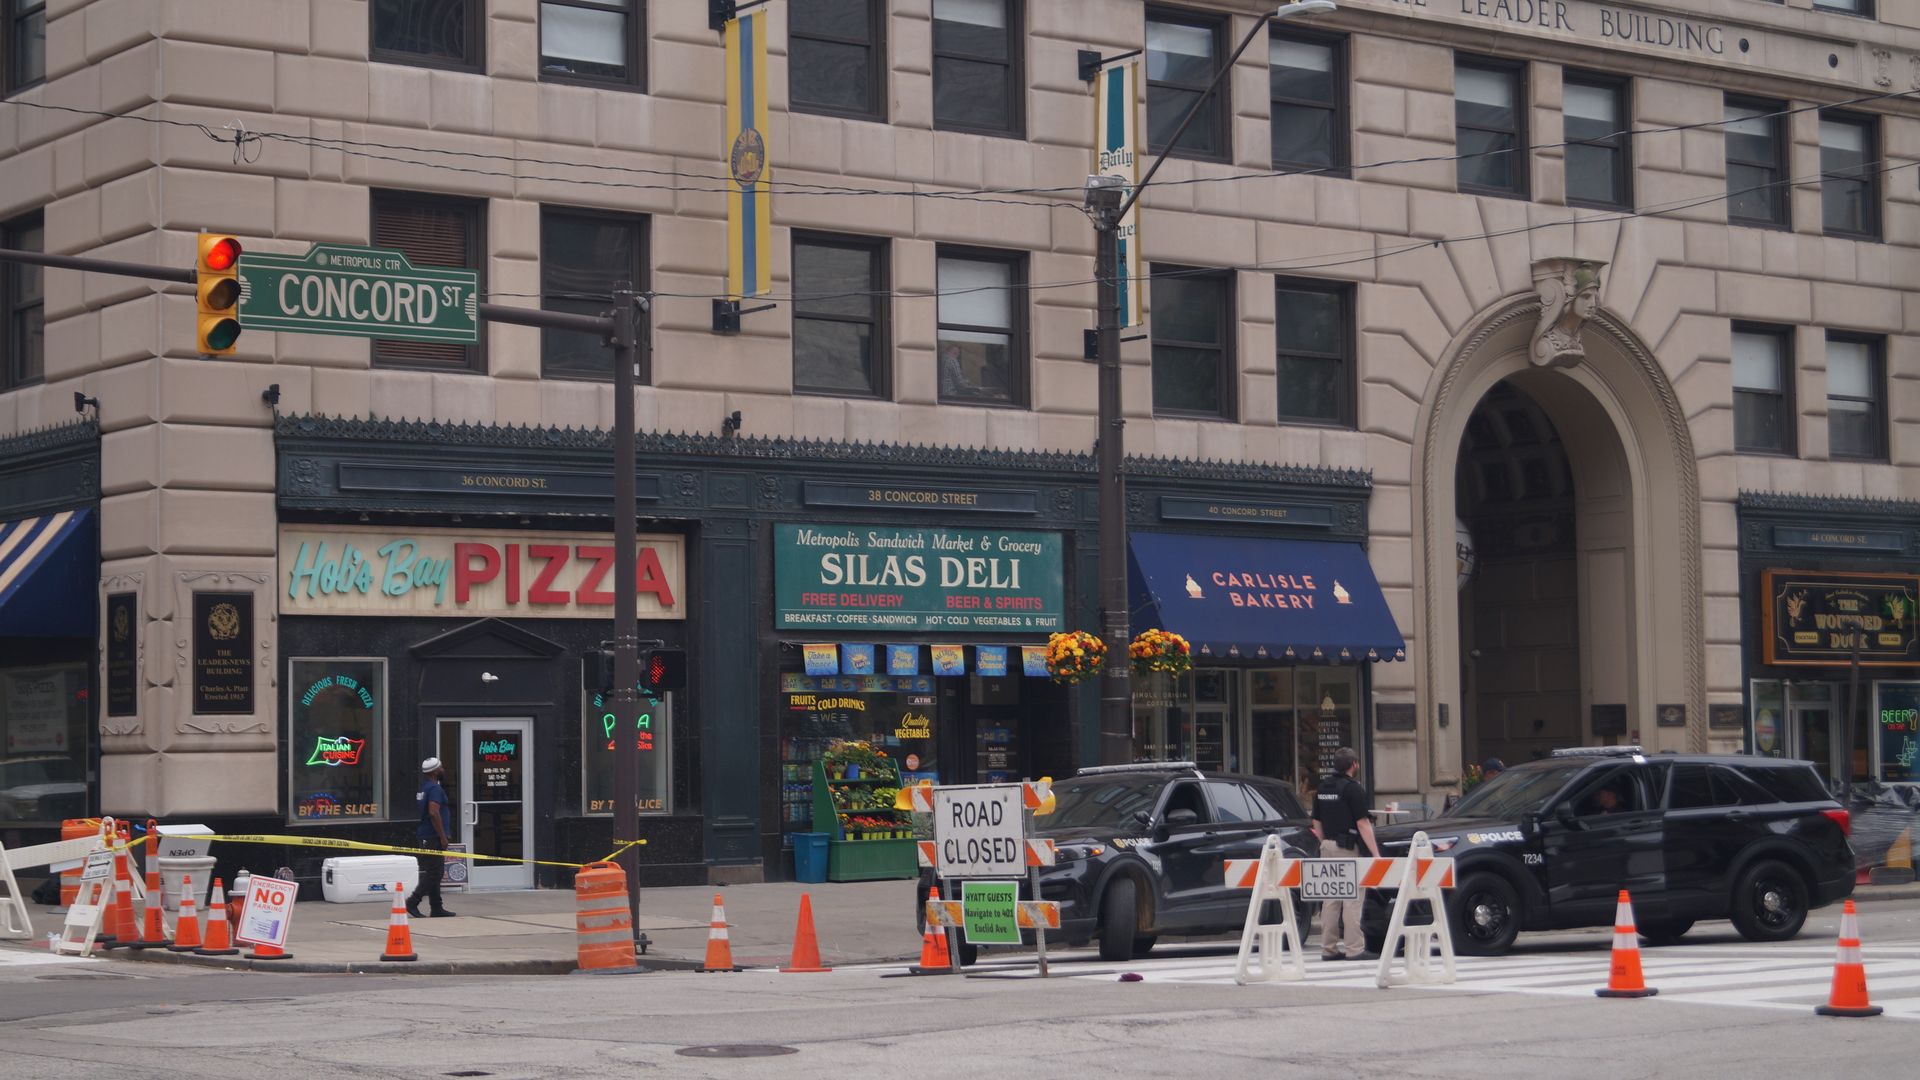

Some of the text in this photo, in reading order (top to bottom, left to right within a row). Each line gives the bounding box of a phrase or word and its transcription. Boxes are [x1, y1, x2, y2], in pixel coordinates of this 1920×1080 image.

[1599, 8, 1723, 54] BUILDING
[1099, 149, 1133, 170] Daily
[330, 254, 400, 270] METROPOLIS CTR
[278, 273, 461, 324] CONCORD ST
[462, 475, 547, 488] 36 CONCORD ST.
[869, 491, 978, 505] 38 CONCORD STREET
[1208, 506, 1287, 518] 40 CONCORD STREET
[797, 528, 1042, 555] Metropolis Sandwich Market & Grocery
[1821, 534, 1855, 544] CONCORD
[288, 539, 676, 610] Hob's Bay PIZZA
[820, 552, 1021, 589] SILAS DELI
[1212, 571, 1317, 590] CARLISLE
[802, 593, 1043, 610] FREE DELIVERY BEER & SPIRITS
[1229, 592, 1314, 609] BAKERY
[974, 616, 1021, 626] VEGETABLES
[1025, 617, 1031, 626] &
[1035, 617, 1057, 627] FRUIT
[302, 675, 374, 709] DELICIOUS FRESH PIZZA
[790, 694, 816, 706] FRUITS
[817, 700, 837, 711] COLD
[839, 698, 866, 712] DRINKS
[901, 712, 930, 728] Quality
[1881, 709, 1908, 723] BEER
[639, 731, 653, 740] the
[895, 728, 930, 739] VEGETABLES
[319, 743, 351, 751] ITALIAN
[498, 739, 515, 755] Bay
[637, 740, 653, 750] Slice
[322, 751, 356, 760] CUISINE
[299, 803, 378, 817] BY THE SLICE
[591, 800, 605, 810] BY
[638, 799, 662, 809] LICE
[952, 800, 1003, 828] ROAD
[1480, 831, 1524, 842] POLICE
[170, 849, 195, 857] OPEN
[944, 837, 1017, 864] CLOSED
[1523, 853, 1543, 864] 7234
[1311, 863, 1346, 878] LANE
[253, 880, 293, 891] EMERGENCY
[1304, 881, 1354, 896] CLOSED
[255, 887, 285, 906] NO
[966, 893, 1012, 902] HYATT GUESTS
[253, 902, 283, 912] PARKING
[965, 909, 993, 919] Navigate
[974, 924, 1007, 934] Euclid Ave
